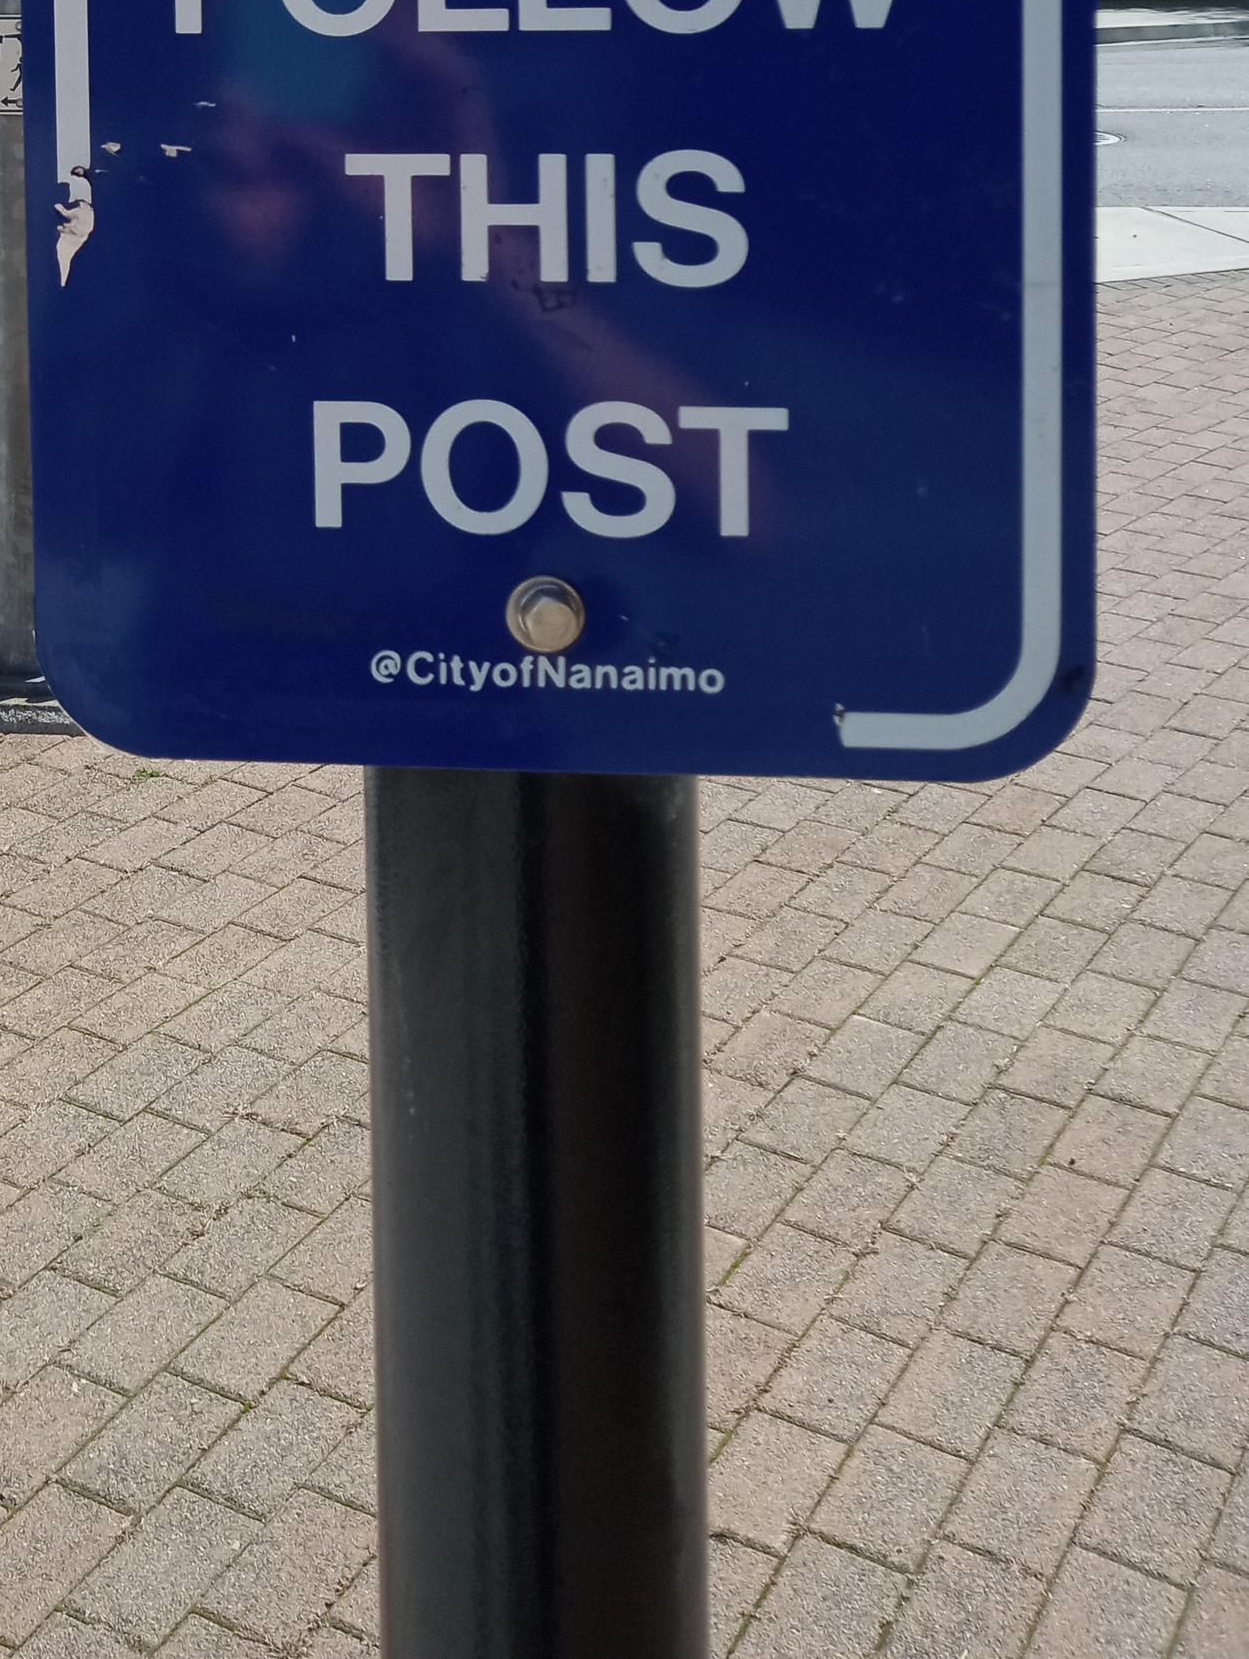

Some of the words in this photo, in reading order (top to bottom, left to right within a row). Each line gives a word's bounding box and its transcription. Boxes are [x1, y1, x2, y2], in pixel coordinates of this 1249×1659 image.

[345, 150, 747, 287] THIS
[314, 400, 788, 537] POST
[372, 648, 723, 692] @CityofNanaimo
